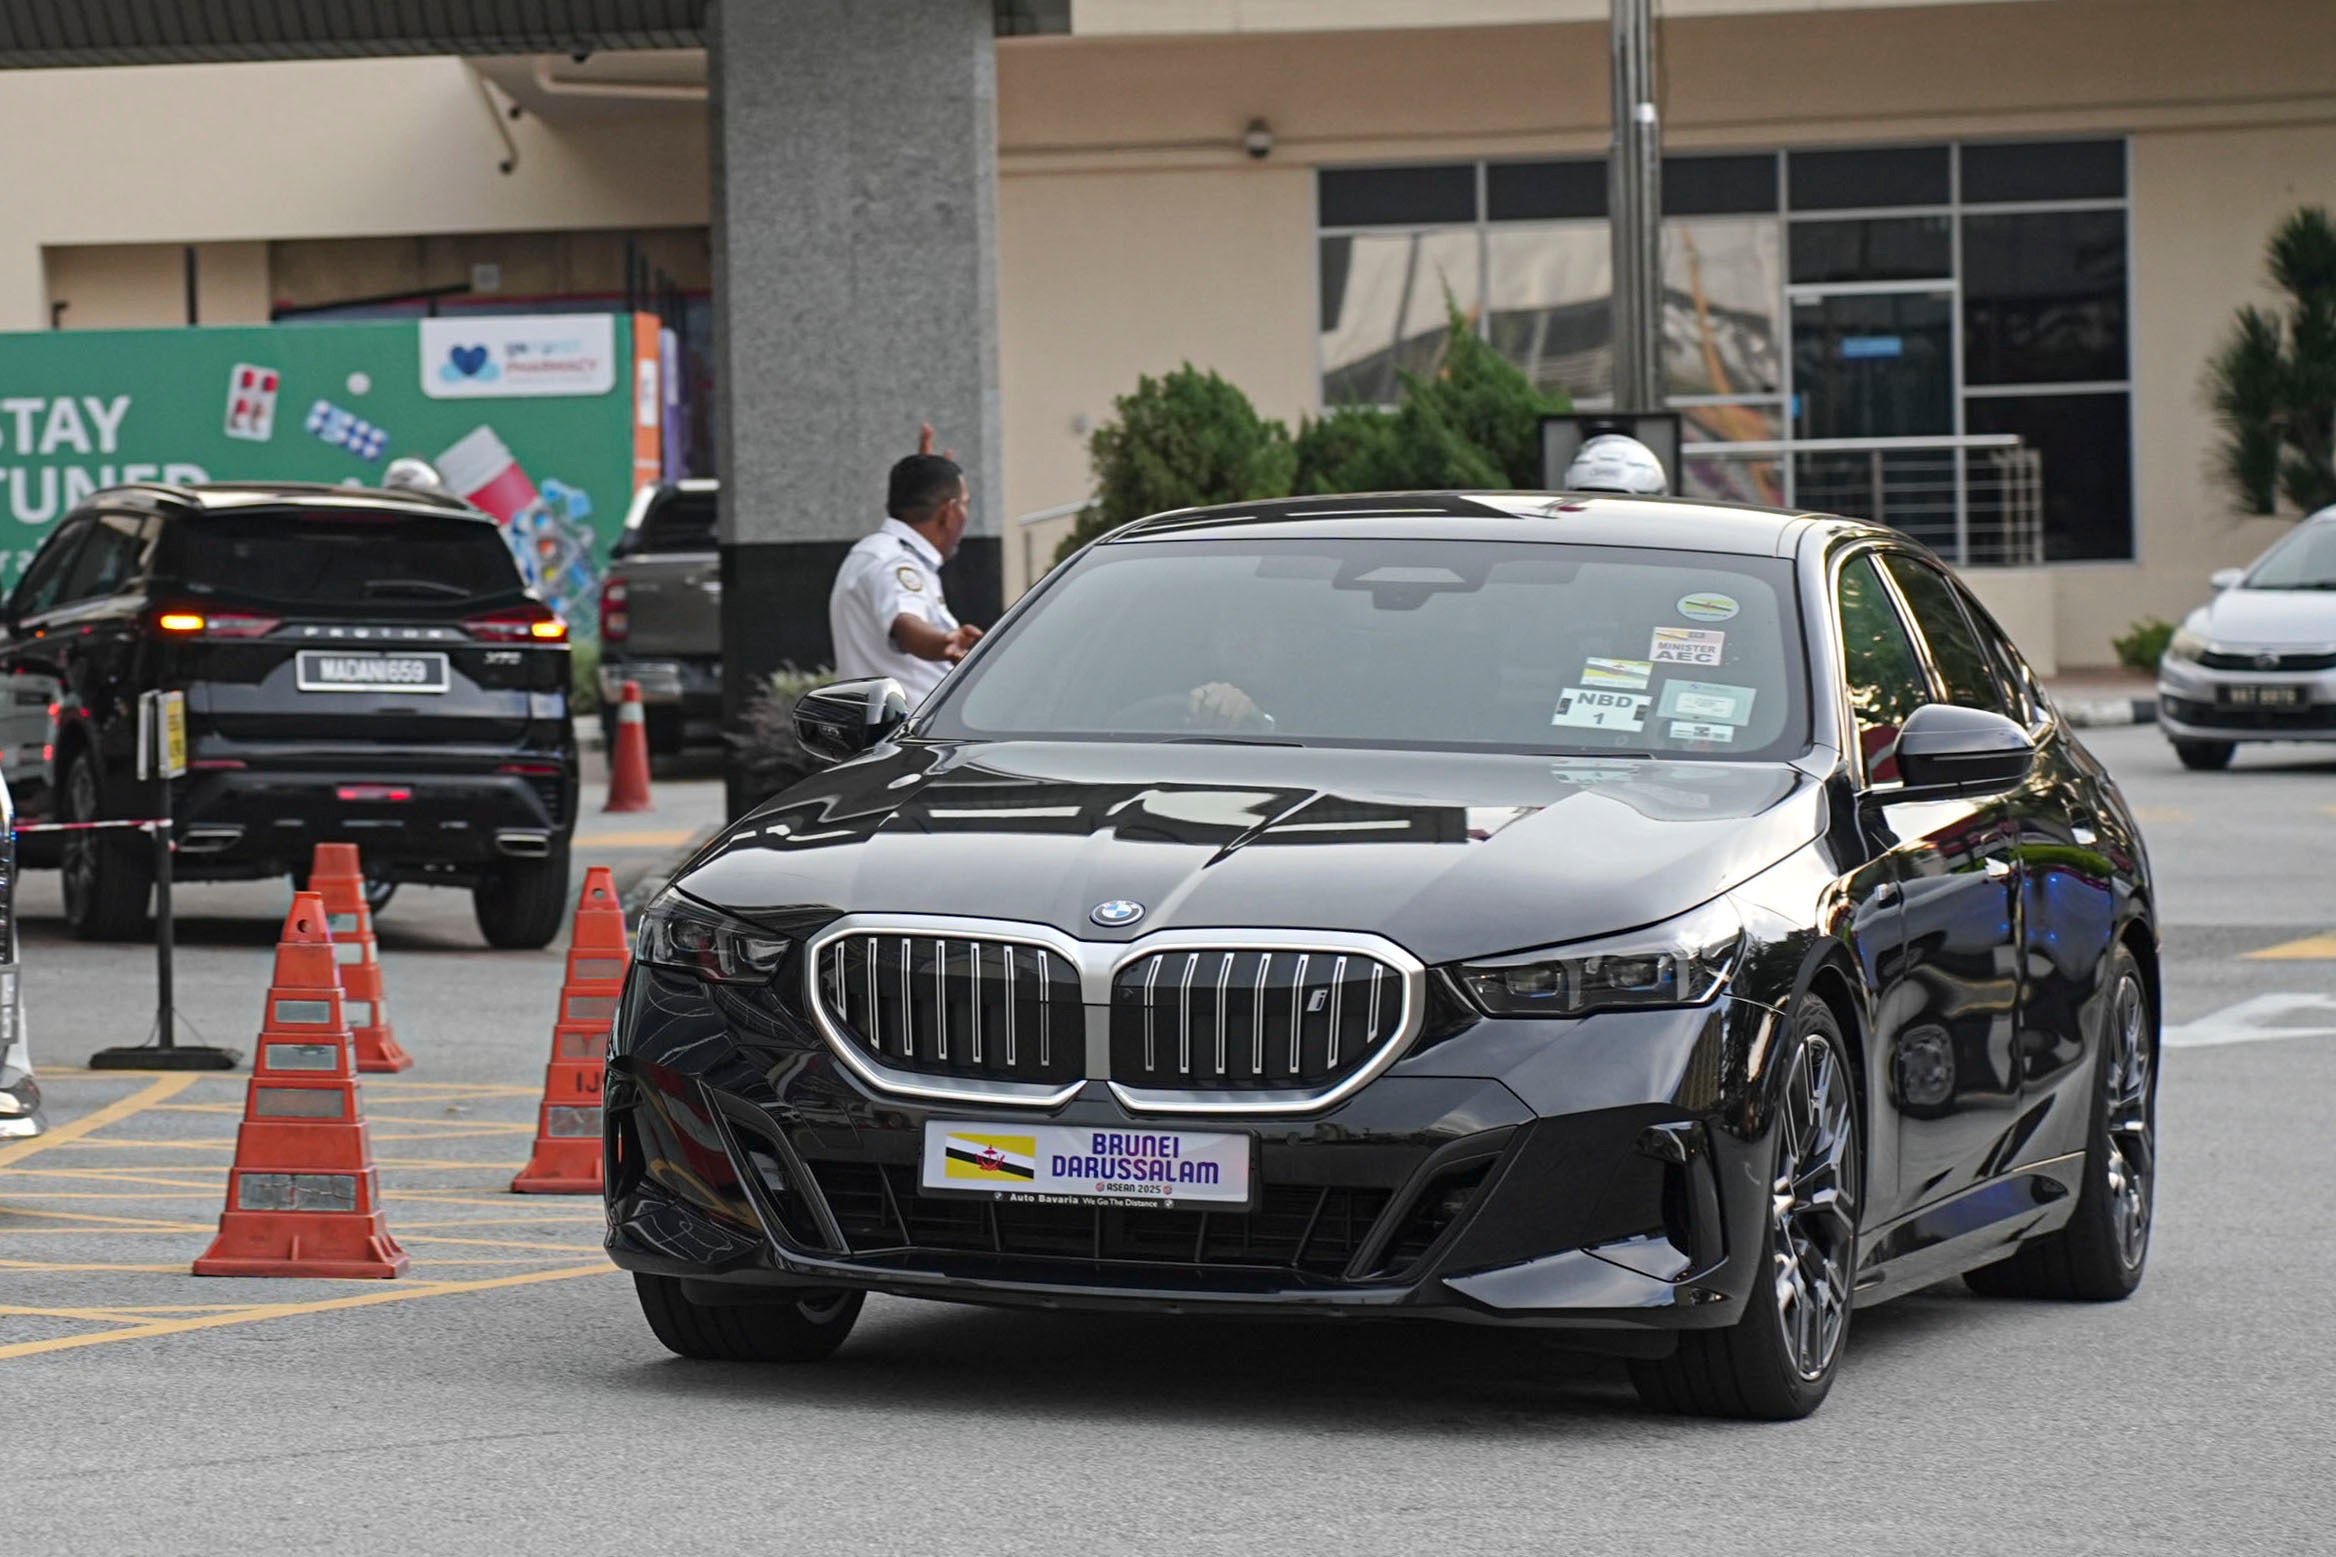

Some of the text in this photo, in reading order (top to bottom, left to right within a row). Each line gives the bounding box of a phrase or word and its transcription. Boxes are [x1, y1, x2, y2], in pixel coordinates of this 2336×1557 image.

[0, 396, 131, 455] TAY
[1657, 641, 1716, 654] MINISTER
[1655, 650, 1712, 662] AEC
[1577, 692, 1633, 708] NBD
[1592, 712, 1605, 725] 1
[1091, 1133, 1179, 1158] BRUNEI
[1051, 1155, 1219, 1184] DARUSSALAM
[1106, 1182, 1162, 1194] ASEAN 2025
[1010, 1193, 1159, 1208] Auto Bavaria We Go The Distance
